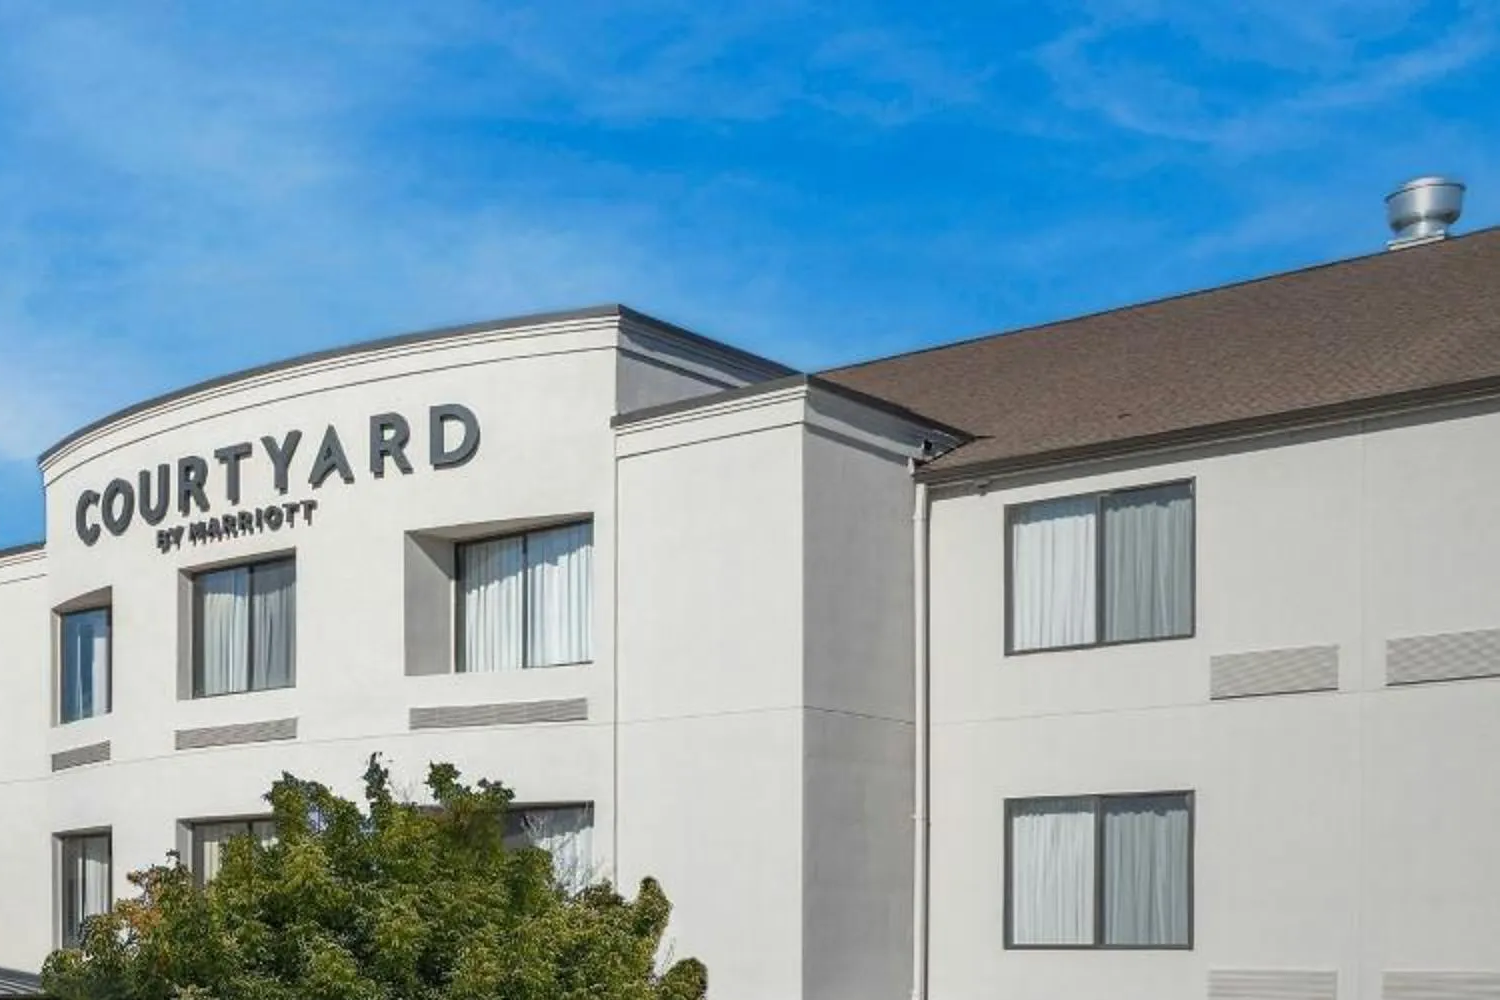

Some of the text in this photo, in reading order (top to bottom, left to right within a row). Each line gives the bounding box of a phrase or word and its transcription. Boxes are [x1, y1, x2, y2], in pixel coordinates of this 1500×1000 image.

[75, 403, 480, 546] COURTYARD
[156, 500, 318, 553] BY MARRIOTT
